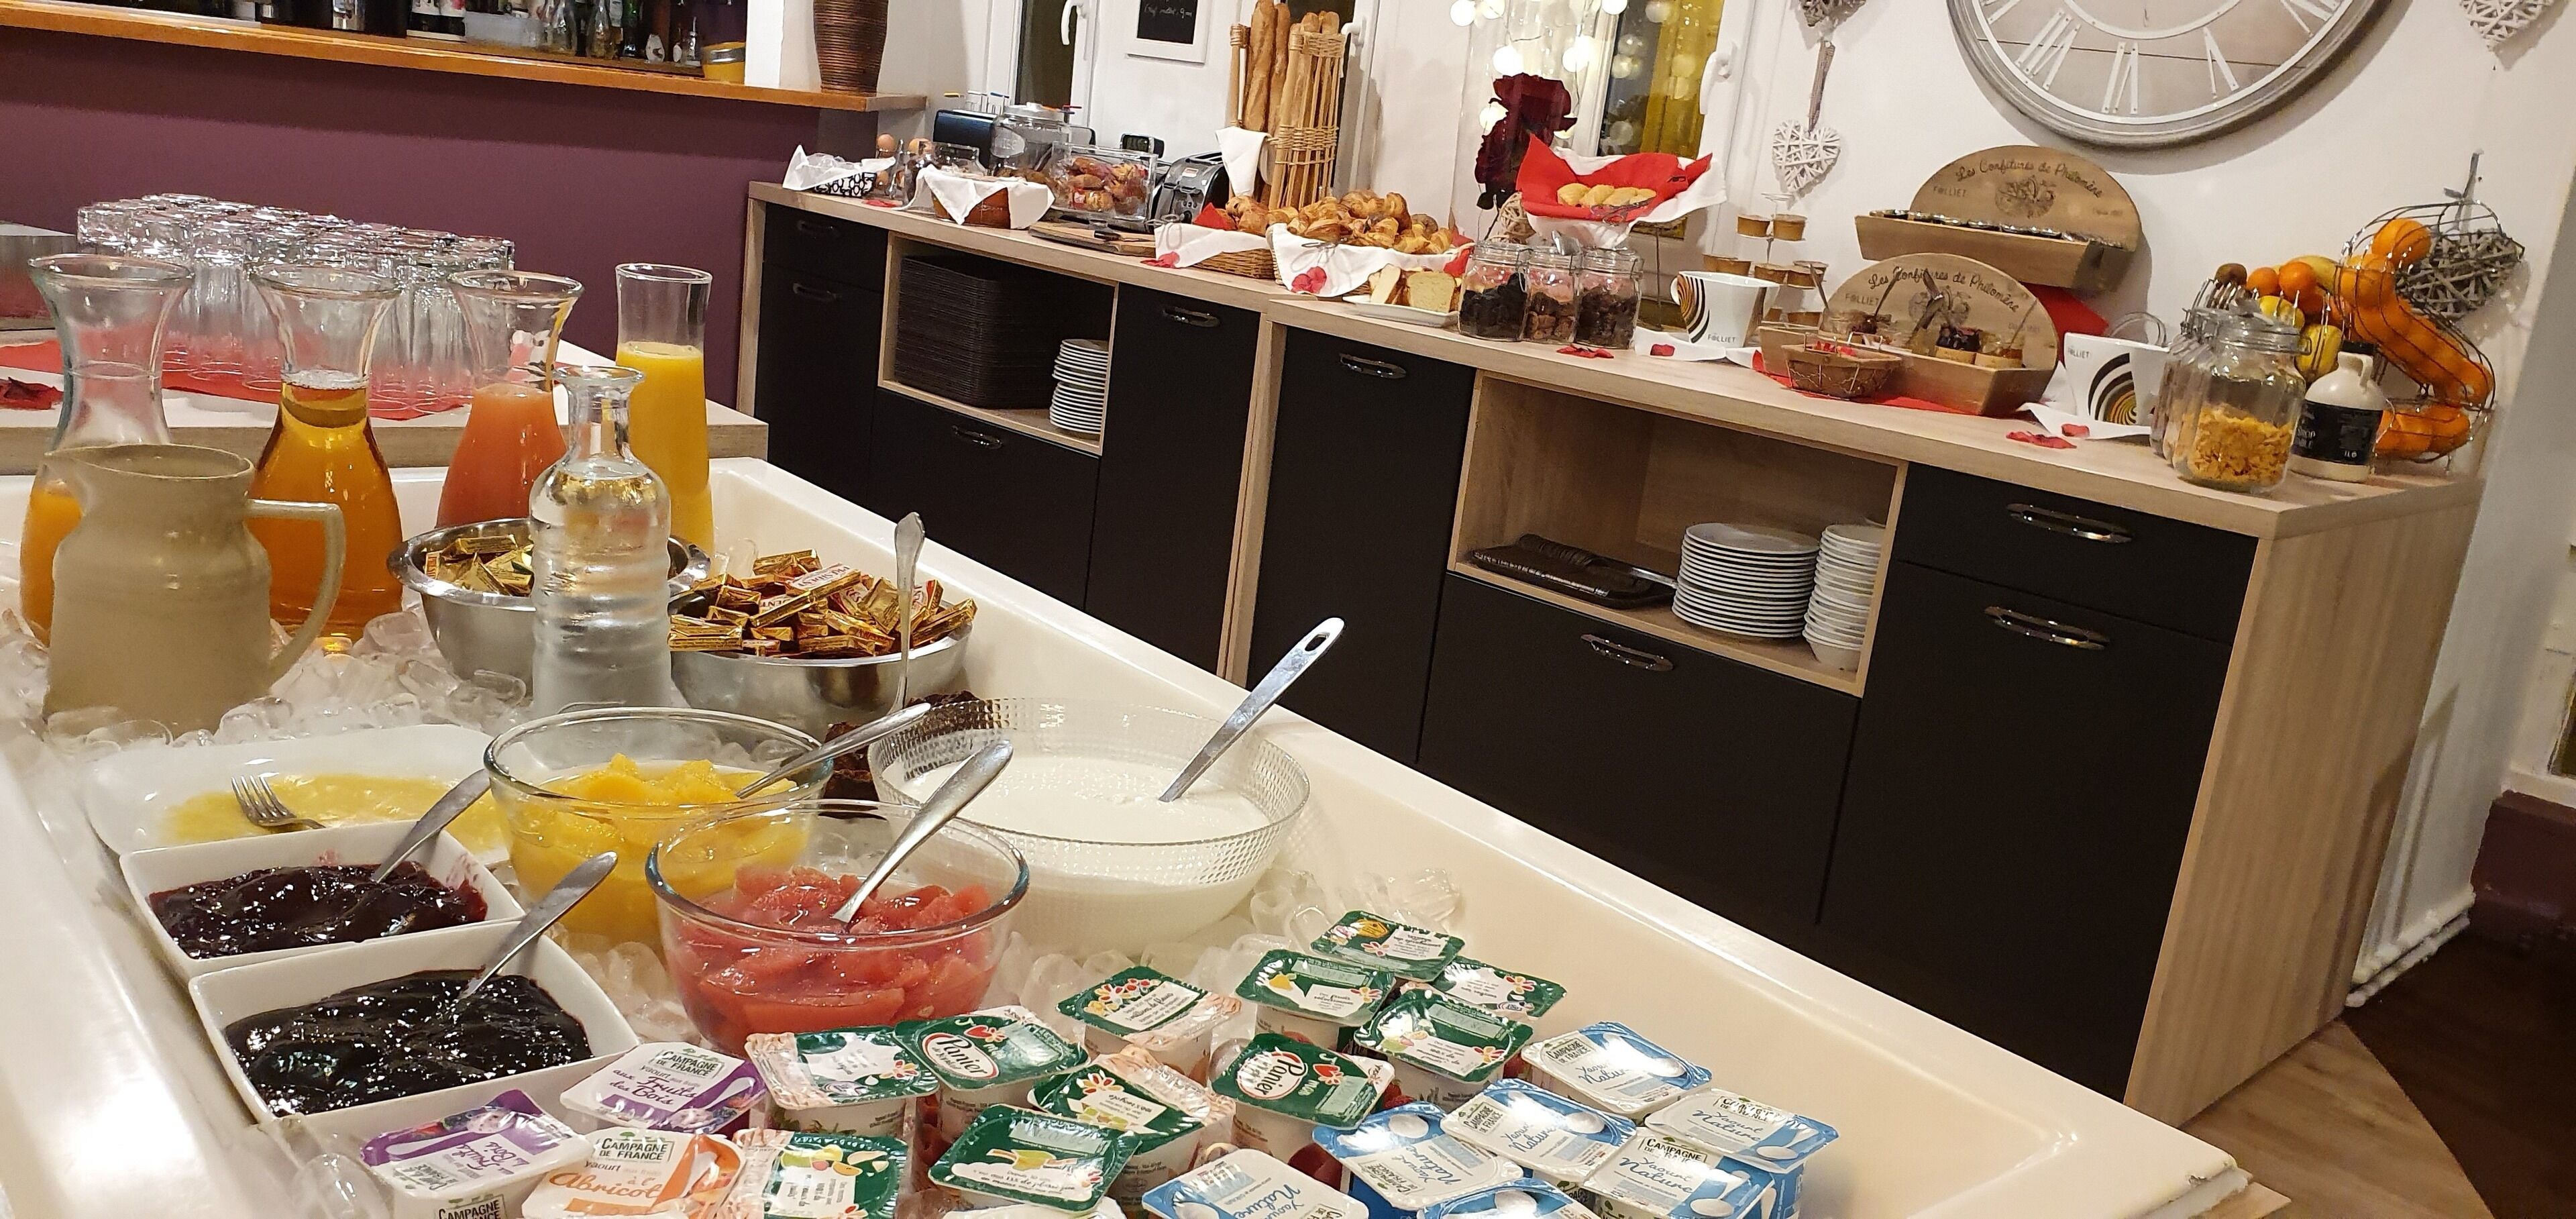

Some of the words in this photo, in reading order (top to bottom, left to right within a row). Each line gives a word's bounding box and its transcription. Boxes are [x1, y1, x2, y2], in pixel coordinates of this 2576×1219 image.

[1955, 166, 1976, 182] Les
[1980, 158, 2036, 174] Confitures
[2038, 163, 2051, 174] de
[1933, 185, 1967, 197] FOLLIET
[1868, 273, 1889, 290] Les
[1953, 270, 1966, 284] de
[1707, 333, 1736, 343] FOLLIET
[936, 1039, 988, 1074] Panier
[1546, 1038, 1583, 1059] CAMPAGNE
[1566, 1045, 1591, 1061] FRANCE
[639, 1065, 672, 1078] yaourt
[656, 1059, 668, 1067] DE
[670, 1061, 713, 1077] FRANCE
[661, 1051, 720, 1071] CAMPAGNE
[612, 1069, 636, 1081] aux
[637, 1075, 698, 1098] Fruits
[1254, 1058, 1307, 1096] Panier
[609, 1079, 630, 1092] des
[631, 1085, 674, 1106] Bois
[1464, 1104, 1494, 1130] CAMPAGNE
[1483, 1112, 1503, 1131] FRANCE
[1692, 1109, 1763, 1141] Nature
[1716, 1111, 1763, 1133] Yaourt
[601, 1137, 668, 1153] CAMPAGNE
[616, 1150, 665, 1161] FRANCE
[1646, 1138, 1702, 1161] CAMPAGNE
[584, 1160, 622, 1172] yaourt
[1391, 1155, 1432, 1183] Yaourt
[1405, 1145, 1462, 1185] Nature
[1619, 1157, 1694, 1193] Nature
[1640, 1157, 1692, 1181] Yaourt
[438, 1199, 501, 1219] CAMPAGNE
